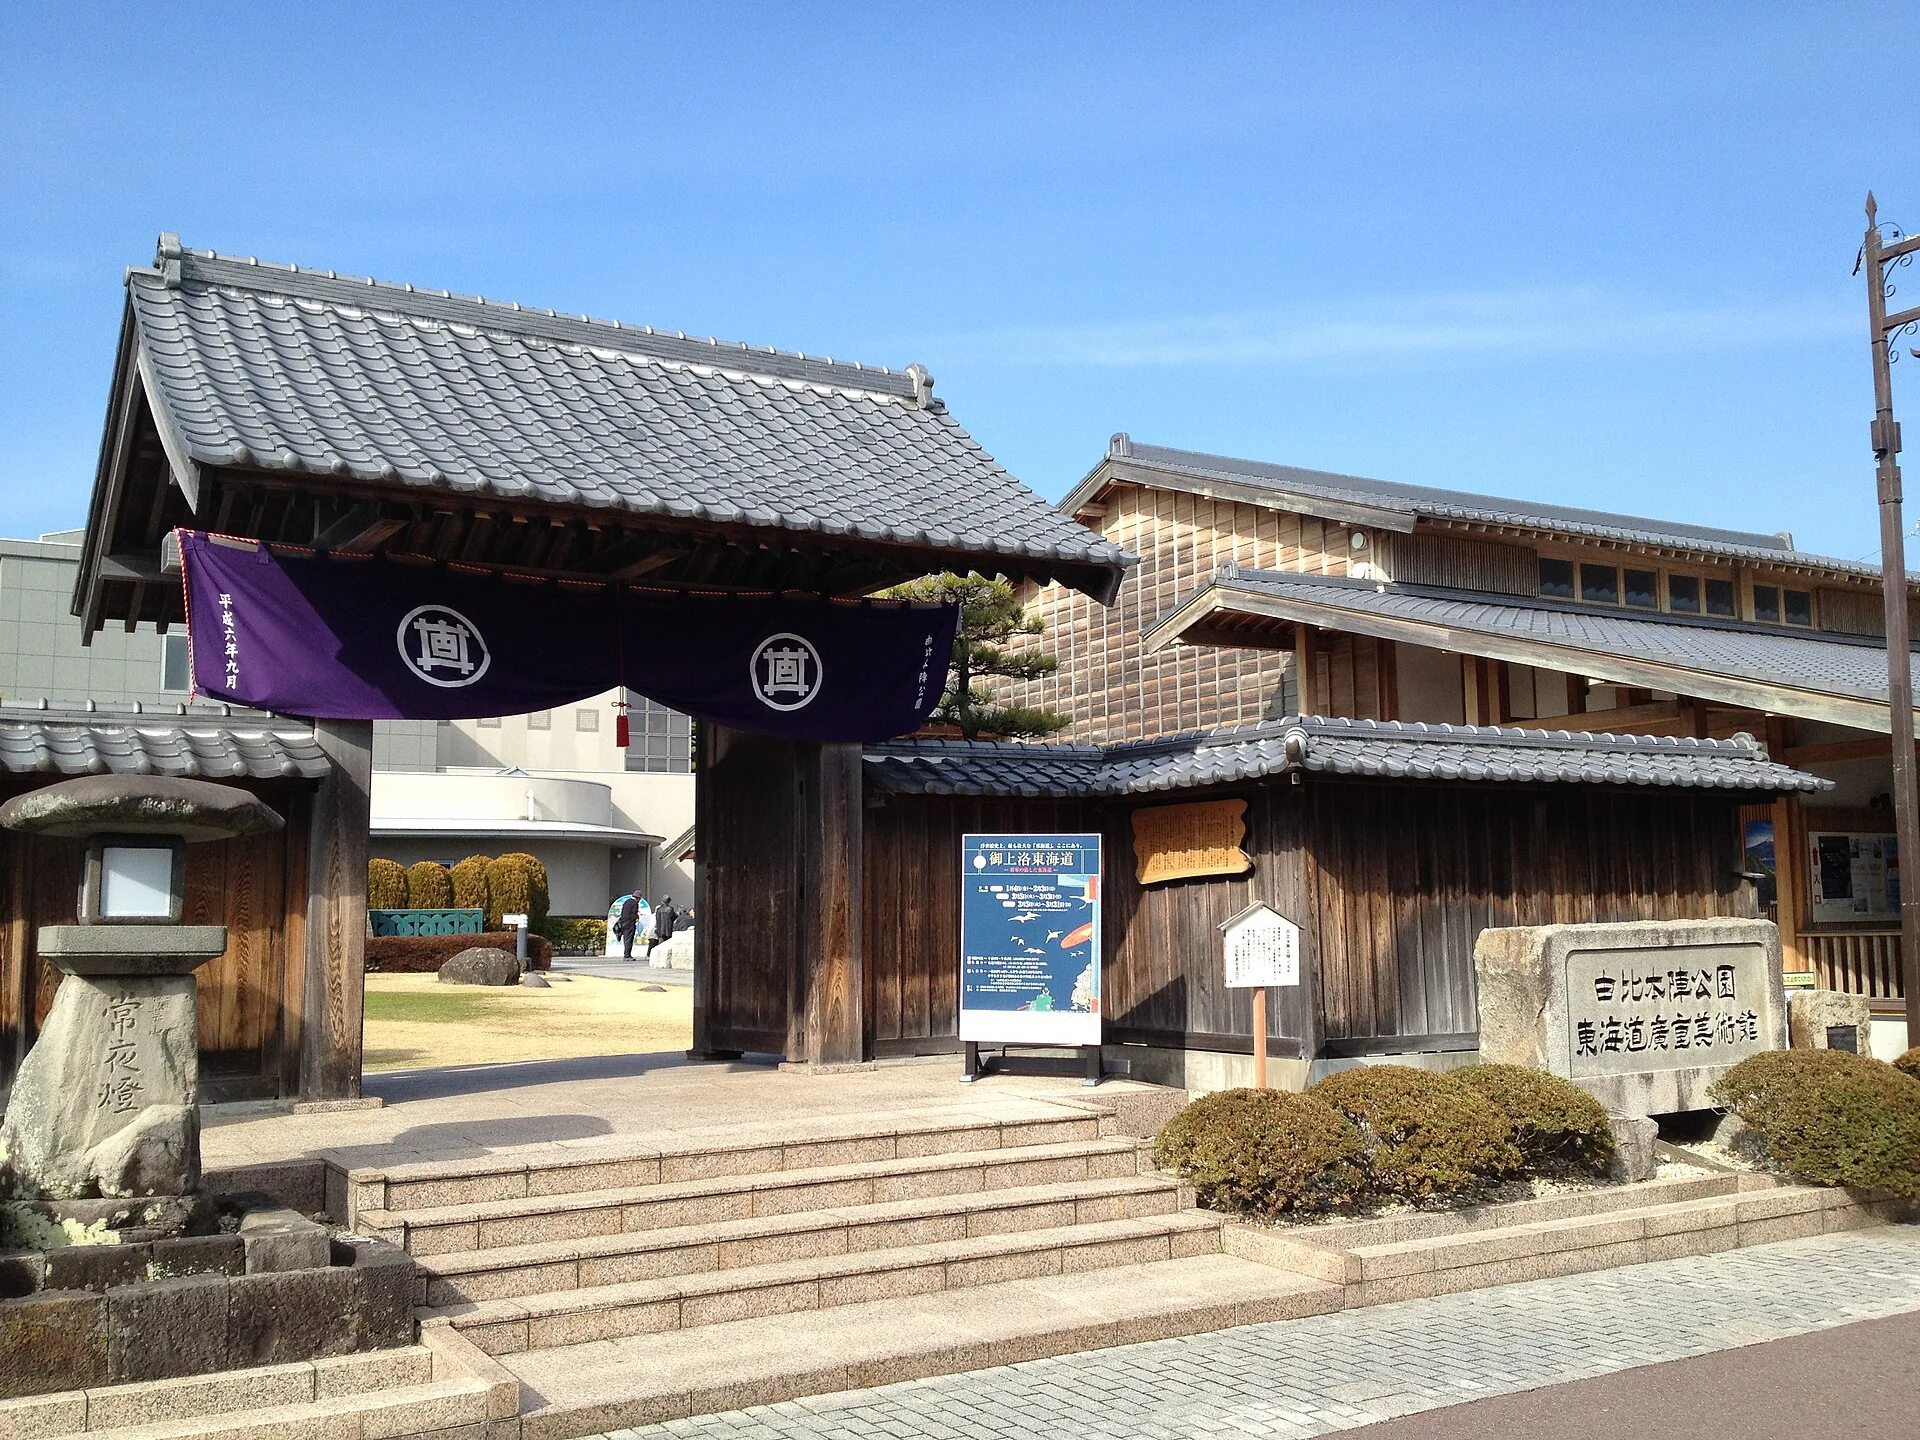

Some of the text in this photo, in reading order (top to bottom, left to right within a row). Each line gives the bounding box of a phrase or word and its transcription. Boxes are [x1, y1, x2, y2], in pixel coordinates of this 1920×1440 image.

[218, 593, 240, 690] 平成六年九月
[989, 851, 1074, 867] 御上洛東海道
[1813, 874, 1822, 904] 入口
[1594, 964, 1736, 1003] 由比本陣公園
[98, 992, 145, 1114] 常夜燈
